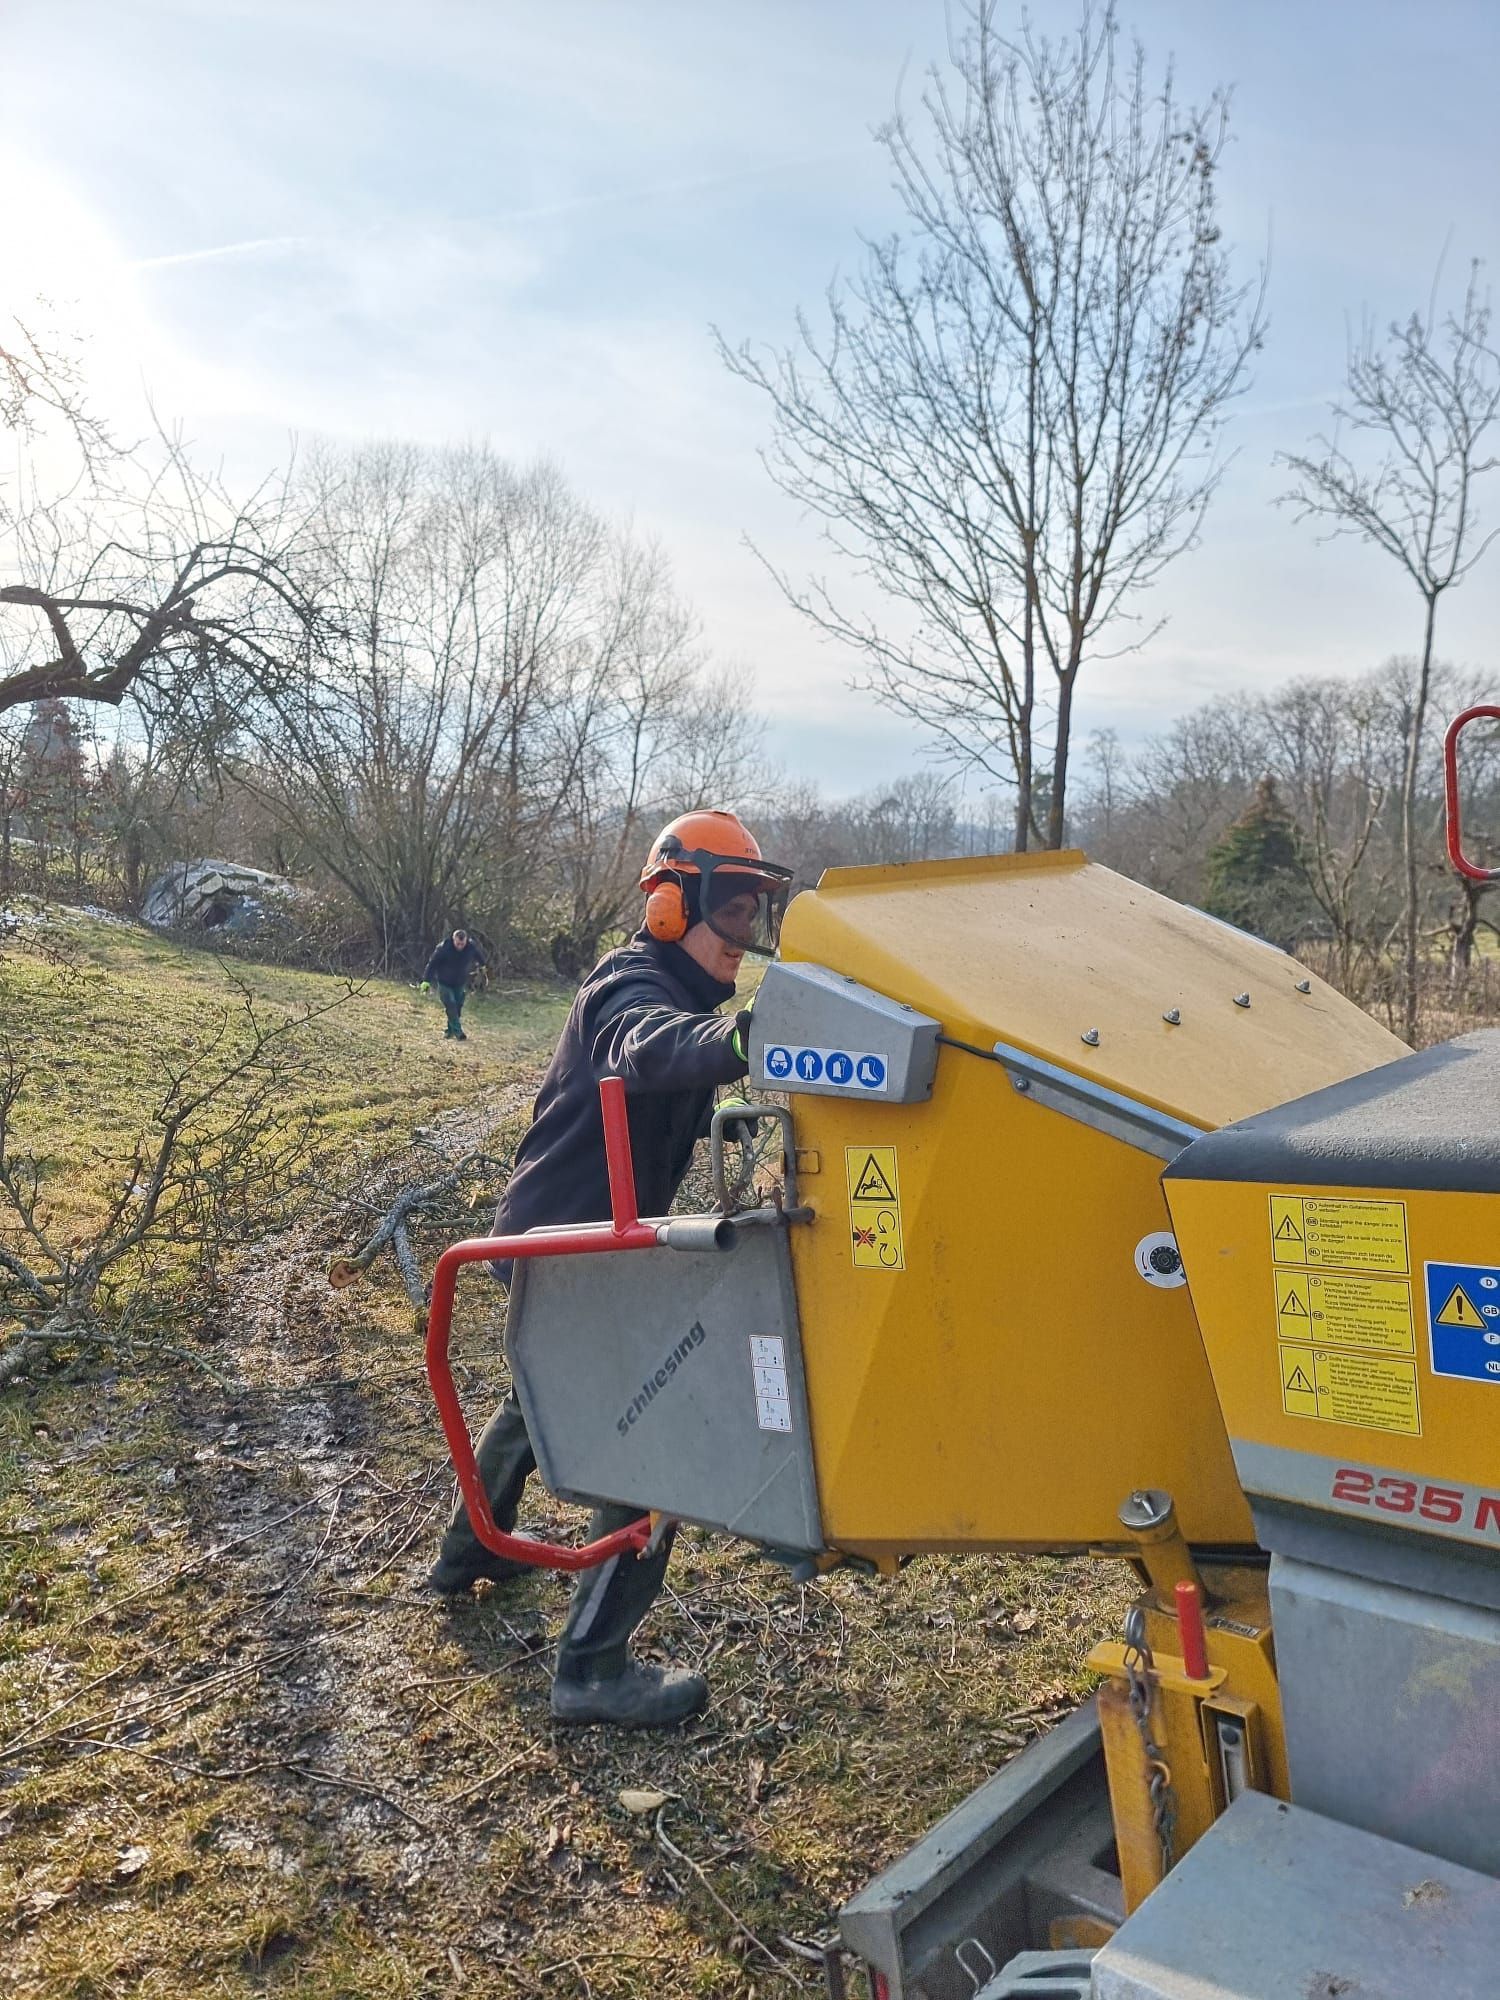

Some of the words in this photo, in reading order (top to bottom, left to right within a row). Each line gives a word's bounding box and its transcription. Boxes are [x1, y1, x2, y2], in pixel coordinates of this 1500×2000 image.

[1485, 1278, 1493, 1287] D
[1483, 1306, 1498, 1315] GB
[1488, 1362, 1500, 1371] NL
[616, 1320, 706, 1437] schliesing
[1332, 1468, 1465, 1524] 235
